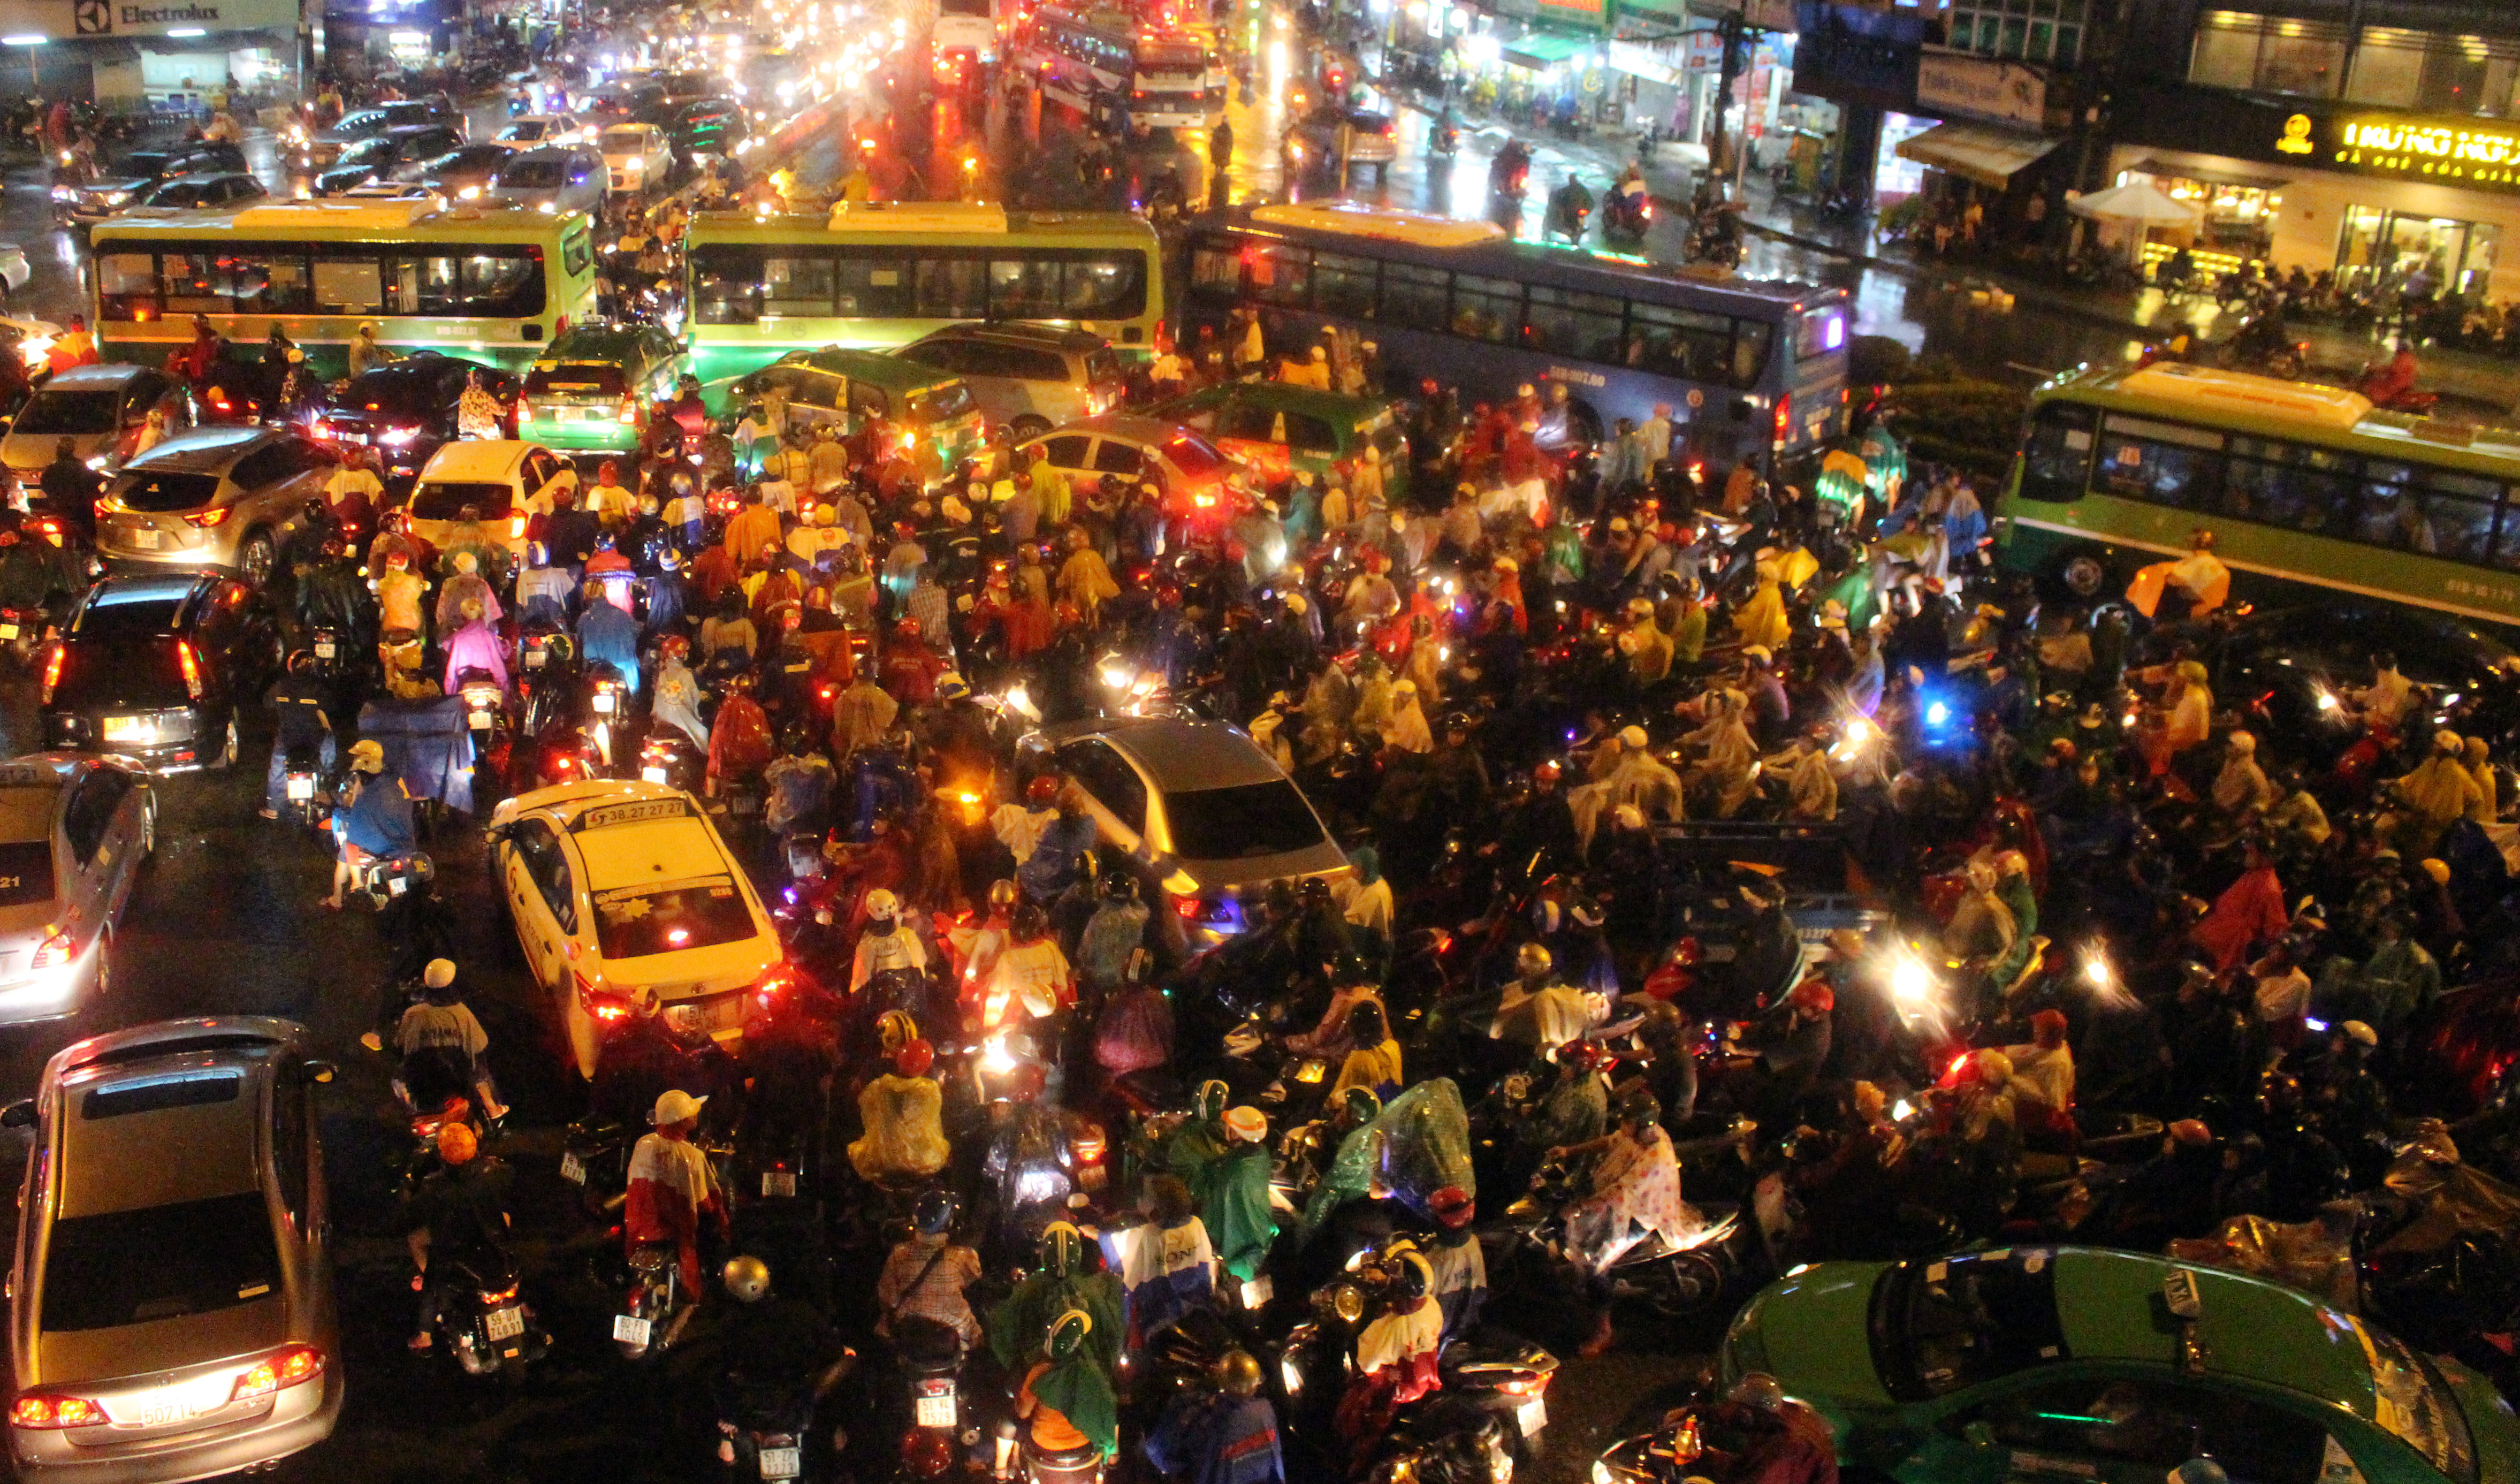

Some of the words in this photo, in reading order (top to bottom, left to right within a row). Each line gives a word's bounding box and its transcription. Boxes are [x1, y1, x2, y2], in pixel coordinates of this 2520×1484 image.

[121, 3, 219, 24] Electrolux
[609, 807, 644, 820] 38.27
[650, 805, 664, 816] 27
[668, 803, 682, 813] 27
[144, 1403, 197, 1425] 507.14
